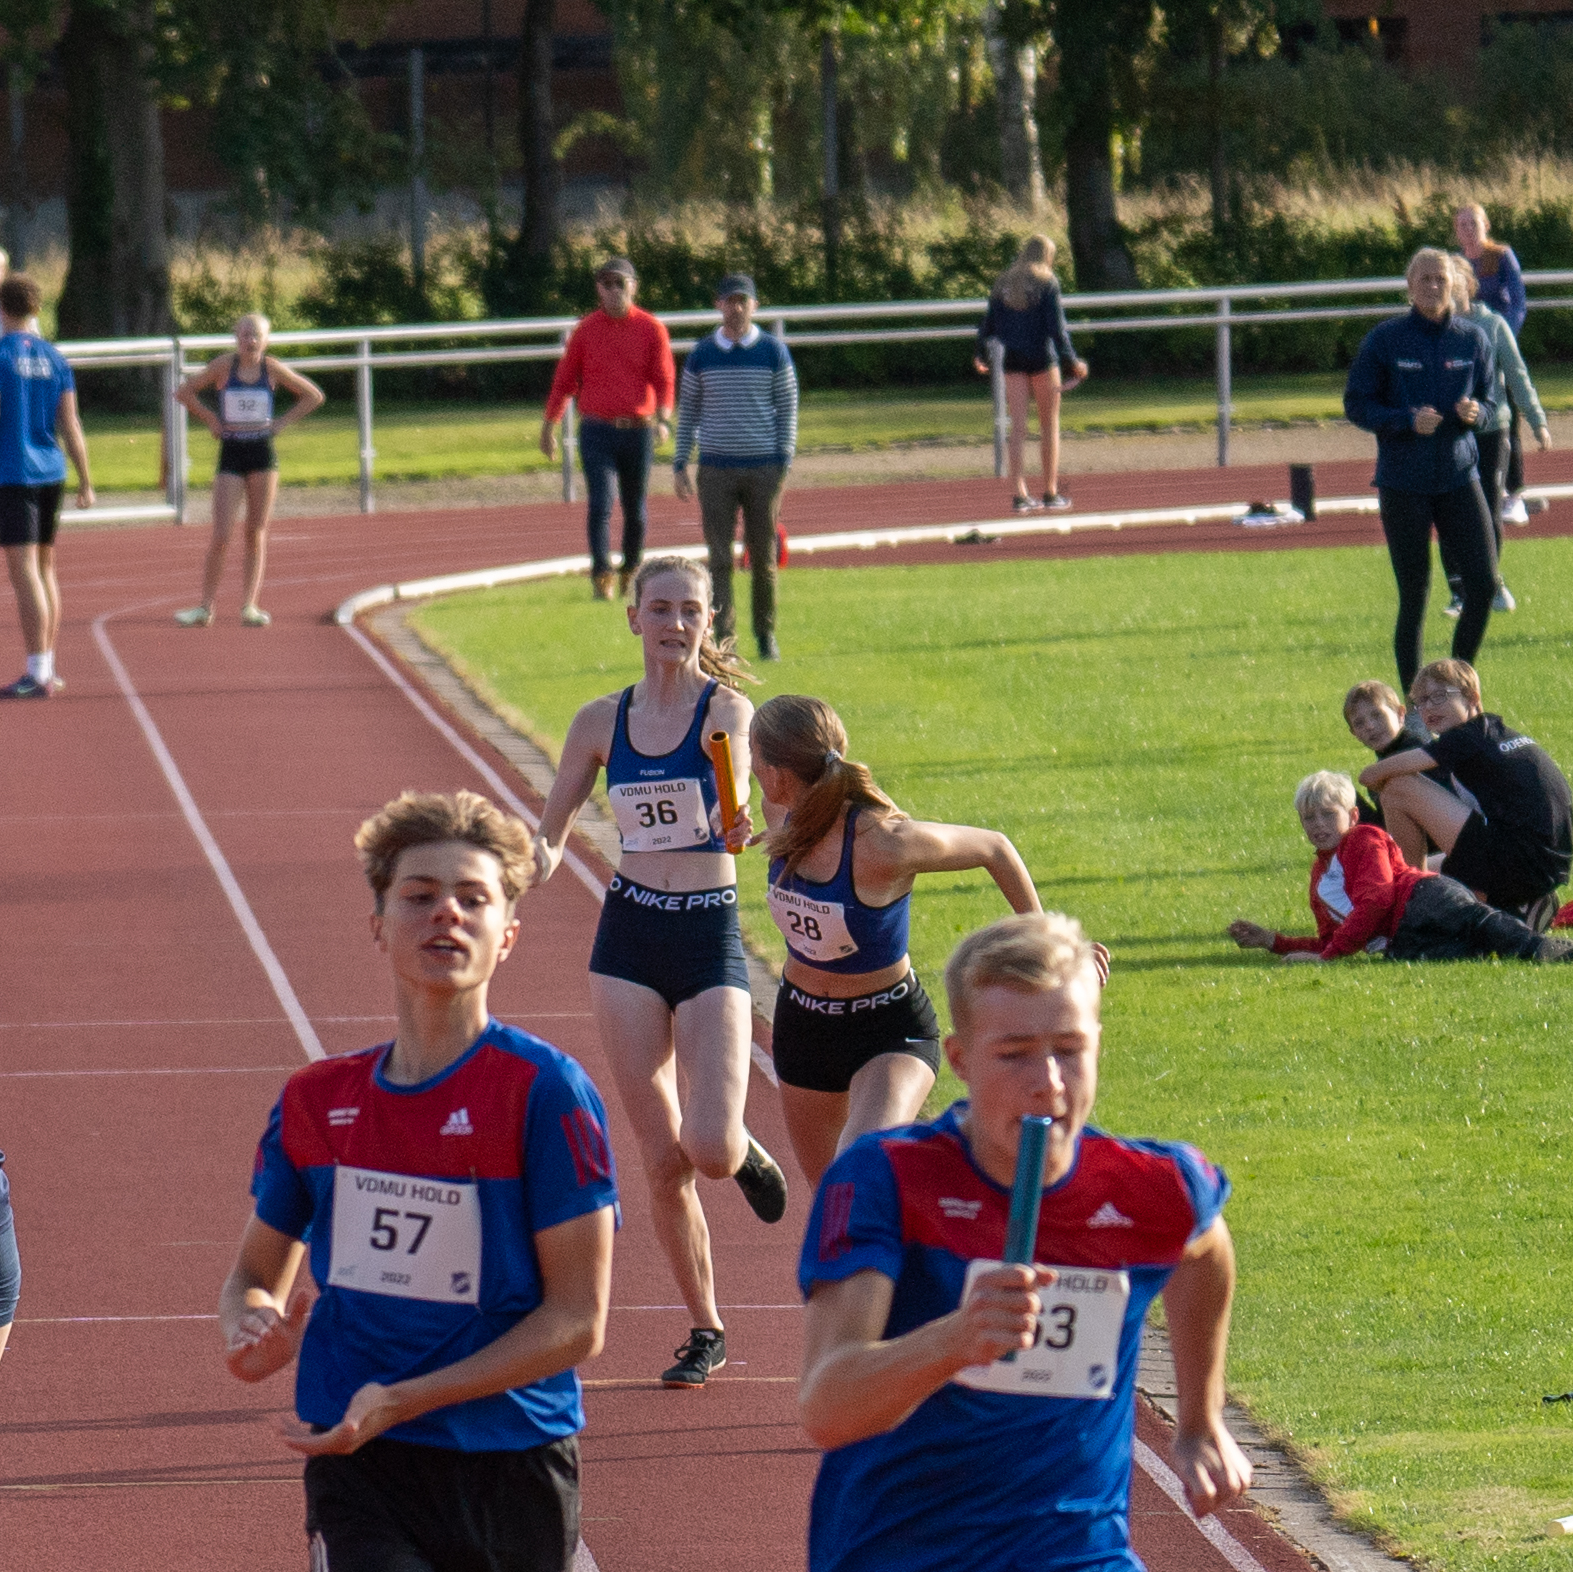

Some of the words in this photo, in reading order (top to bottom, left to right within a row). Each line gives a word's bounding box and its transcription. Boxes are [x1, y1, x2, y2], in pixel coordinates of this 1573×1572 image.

[237, 399, 257, 412] 32
[619, 785, 652, 797] VDMU
[655, 782, 687, 794] HOLD
[635, 800, 679, 829] 36
[652, 836, 672, 845] 2022
[623, 885, 684, 911] NIKE
[685, 889, 737, 911] PRO
[774, 890, 802, 907] VDMU
[803, 899, 831, 915] HOLD
[786, 910, 823, 942] 28
[790, 988, 846, 1016] NIKE
[851, 982, 909, 1014] PRO
[355, 1175, 408, 1198] VDMU
[410, 1184, 462, 1206] HOLD
[369, 1206, 433, 1255] 57
